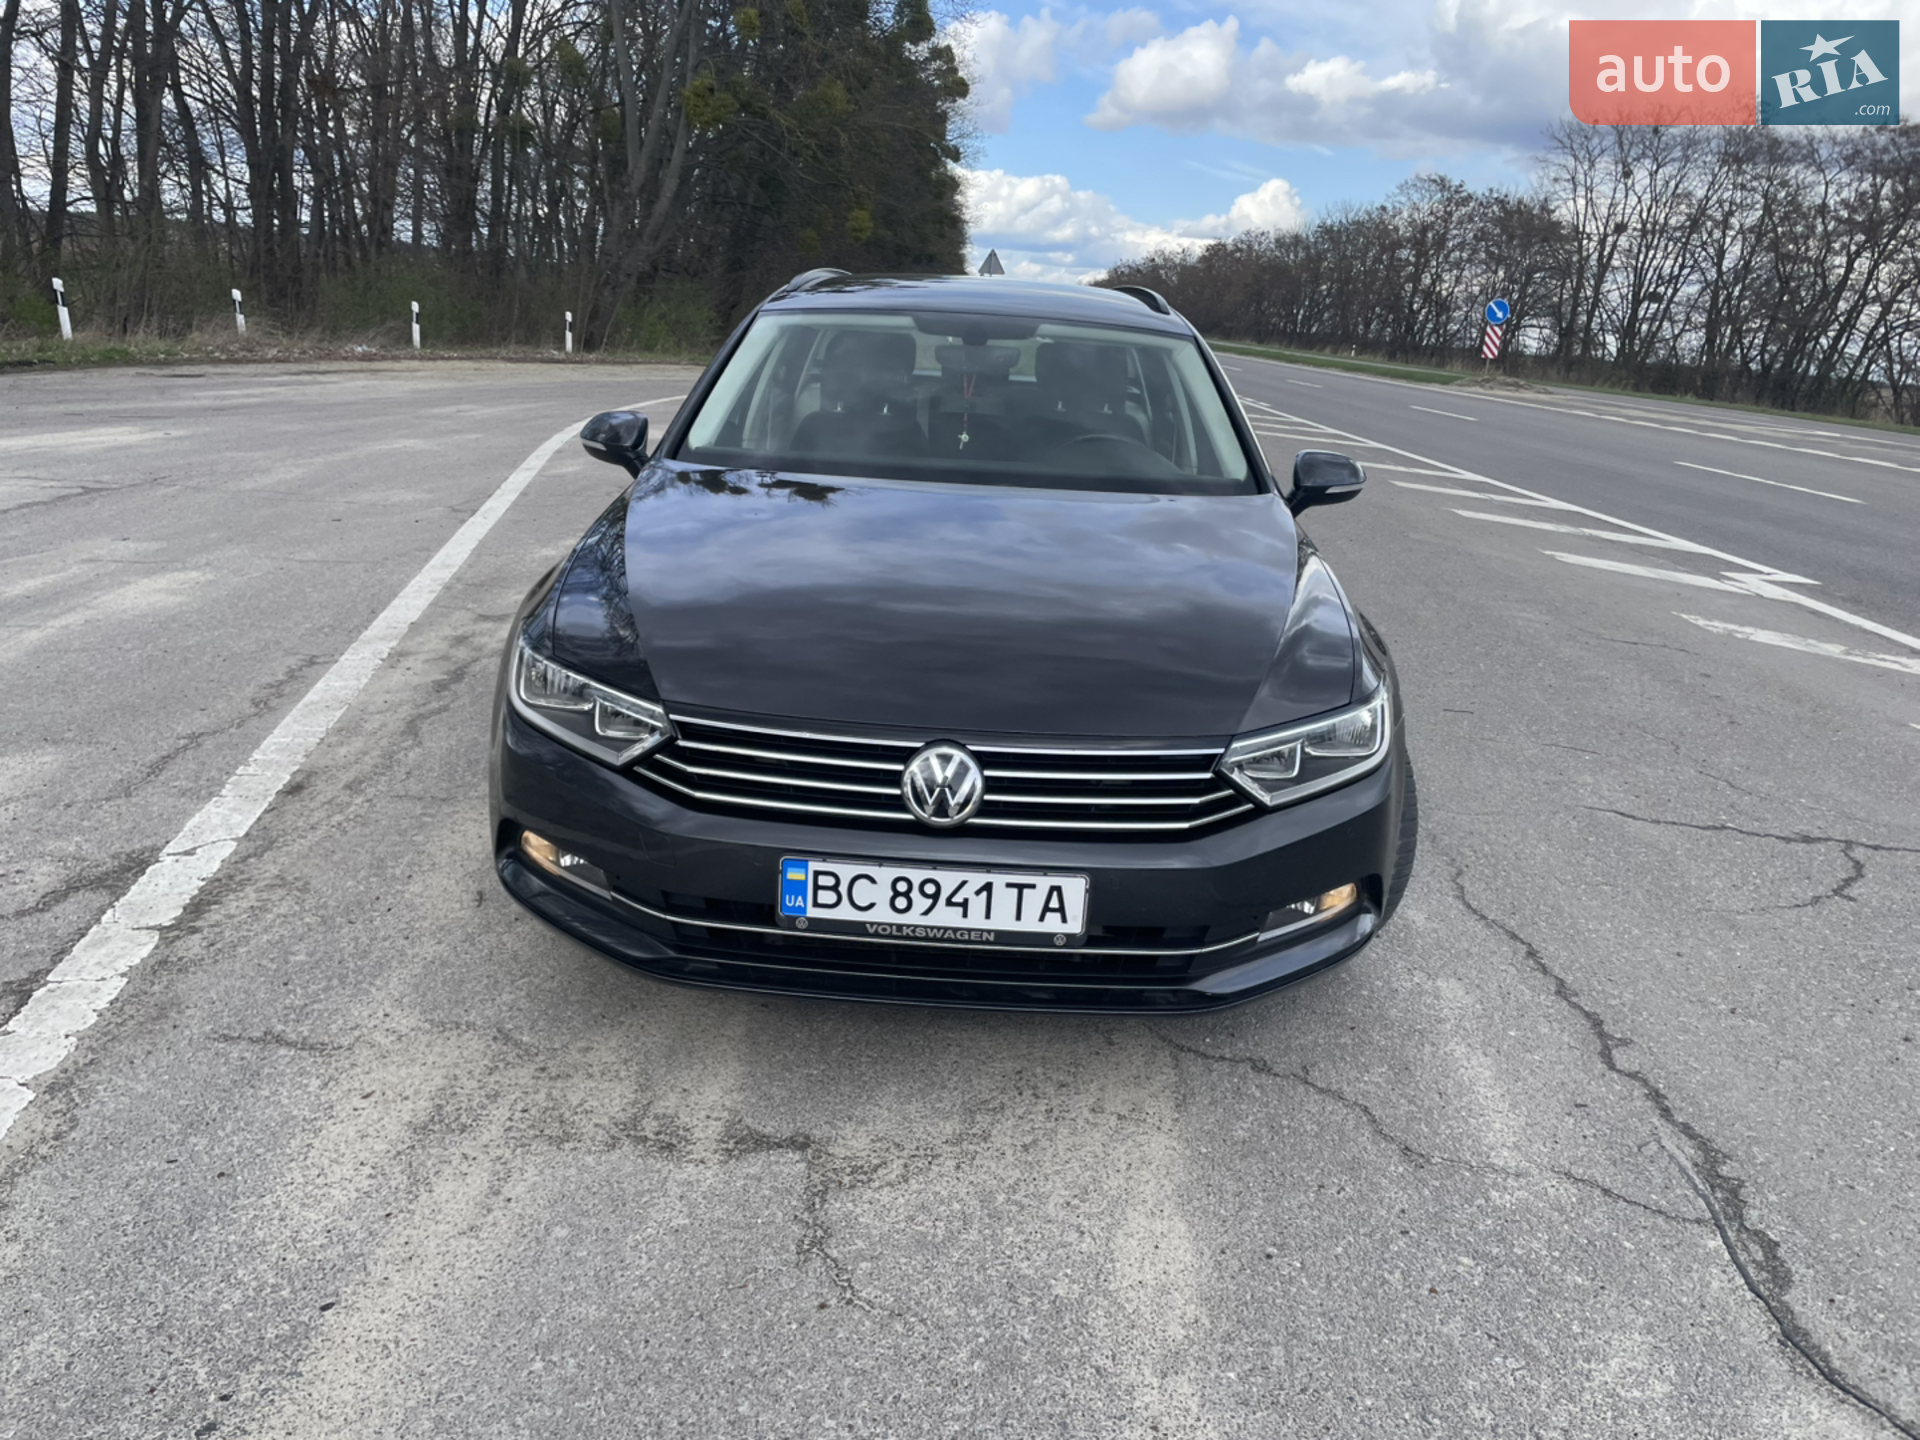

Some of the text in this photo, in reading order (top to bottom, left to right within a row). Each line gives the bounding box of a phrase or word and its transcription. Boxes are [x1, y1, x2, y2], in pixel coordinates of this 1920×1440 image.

[785, 894, 805, 908] UA
[811, 869, 1069, 924] BC 8941 TA
[865, 923, 995, 942] VOLKSWAGEN
